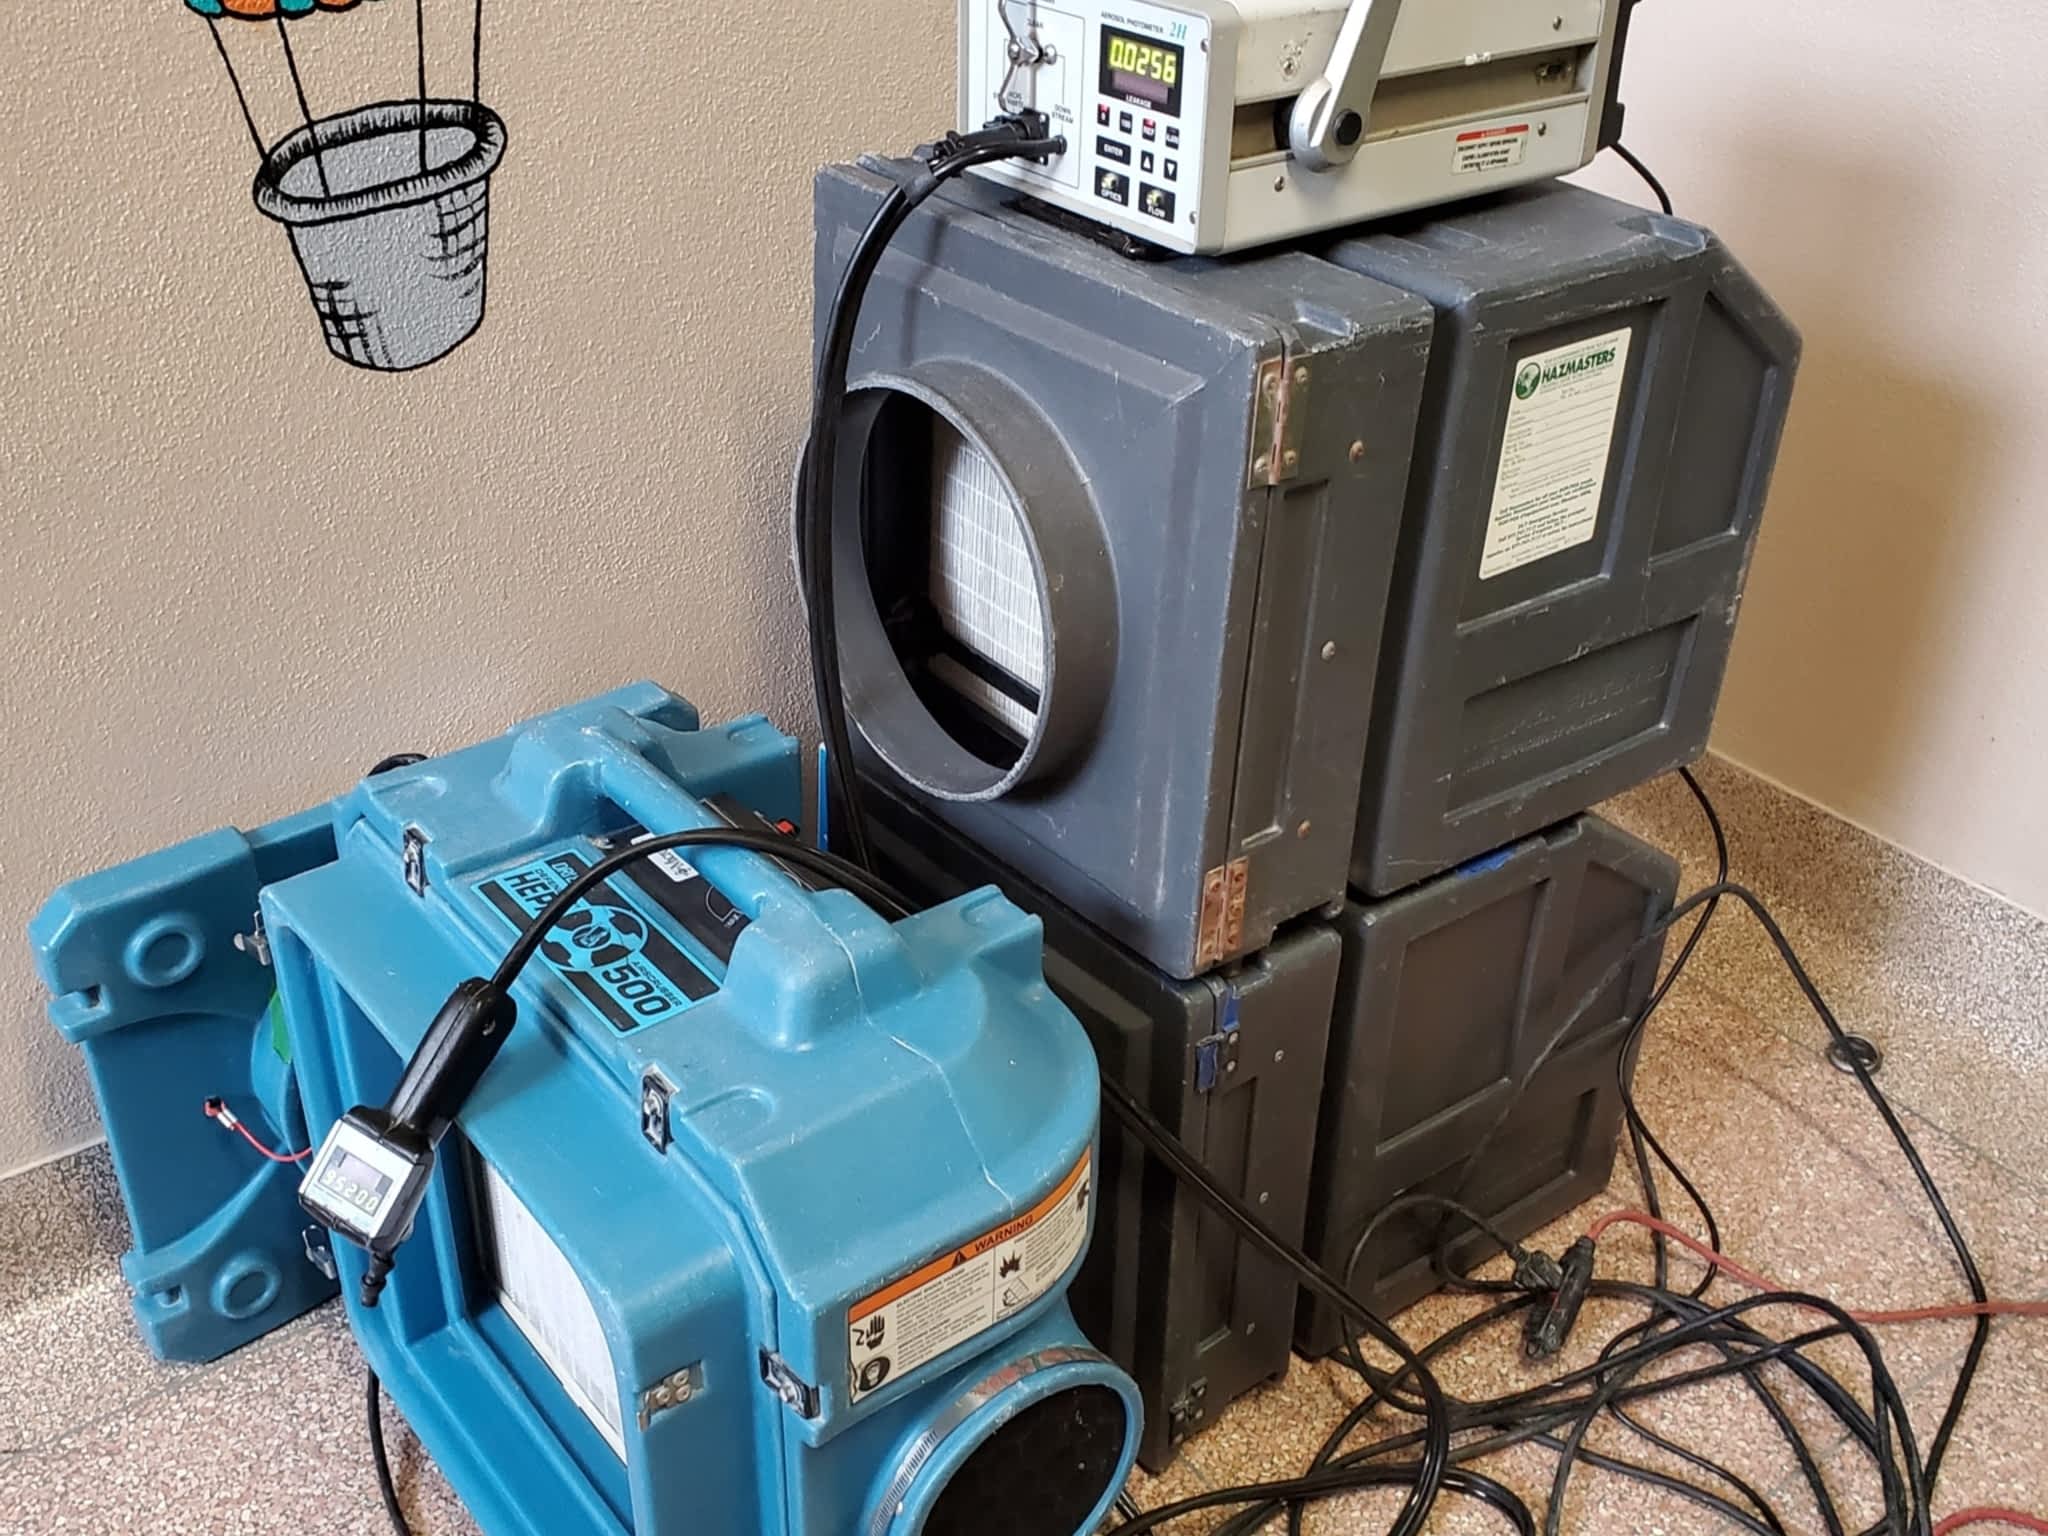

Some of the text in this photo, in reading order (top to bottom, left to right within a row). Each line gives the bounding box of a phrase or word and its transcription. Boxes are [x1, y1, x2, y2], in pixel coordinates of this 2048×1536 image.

[1541, 347, 1616, 384] HAZMASTERS
[602, 964, 672, 1016] 500
[974, 1214, 1034, 1252] WARNING
